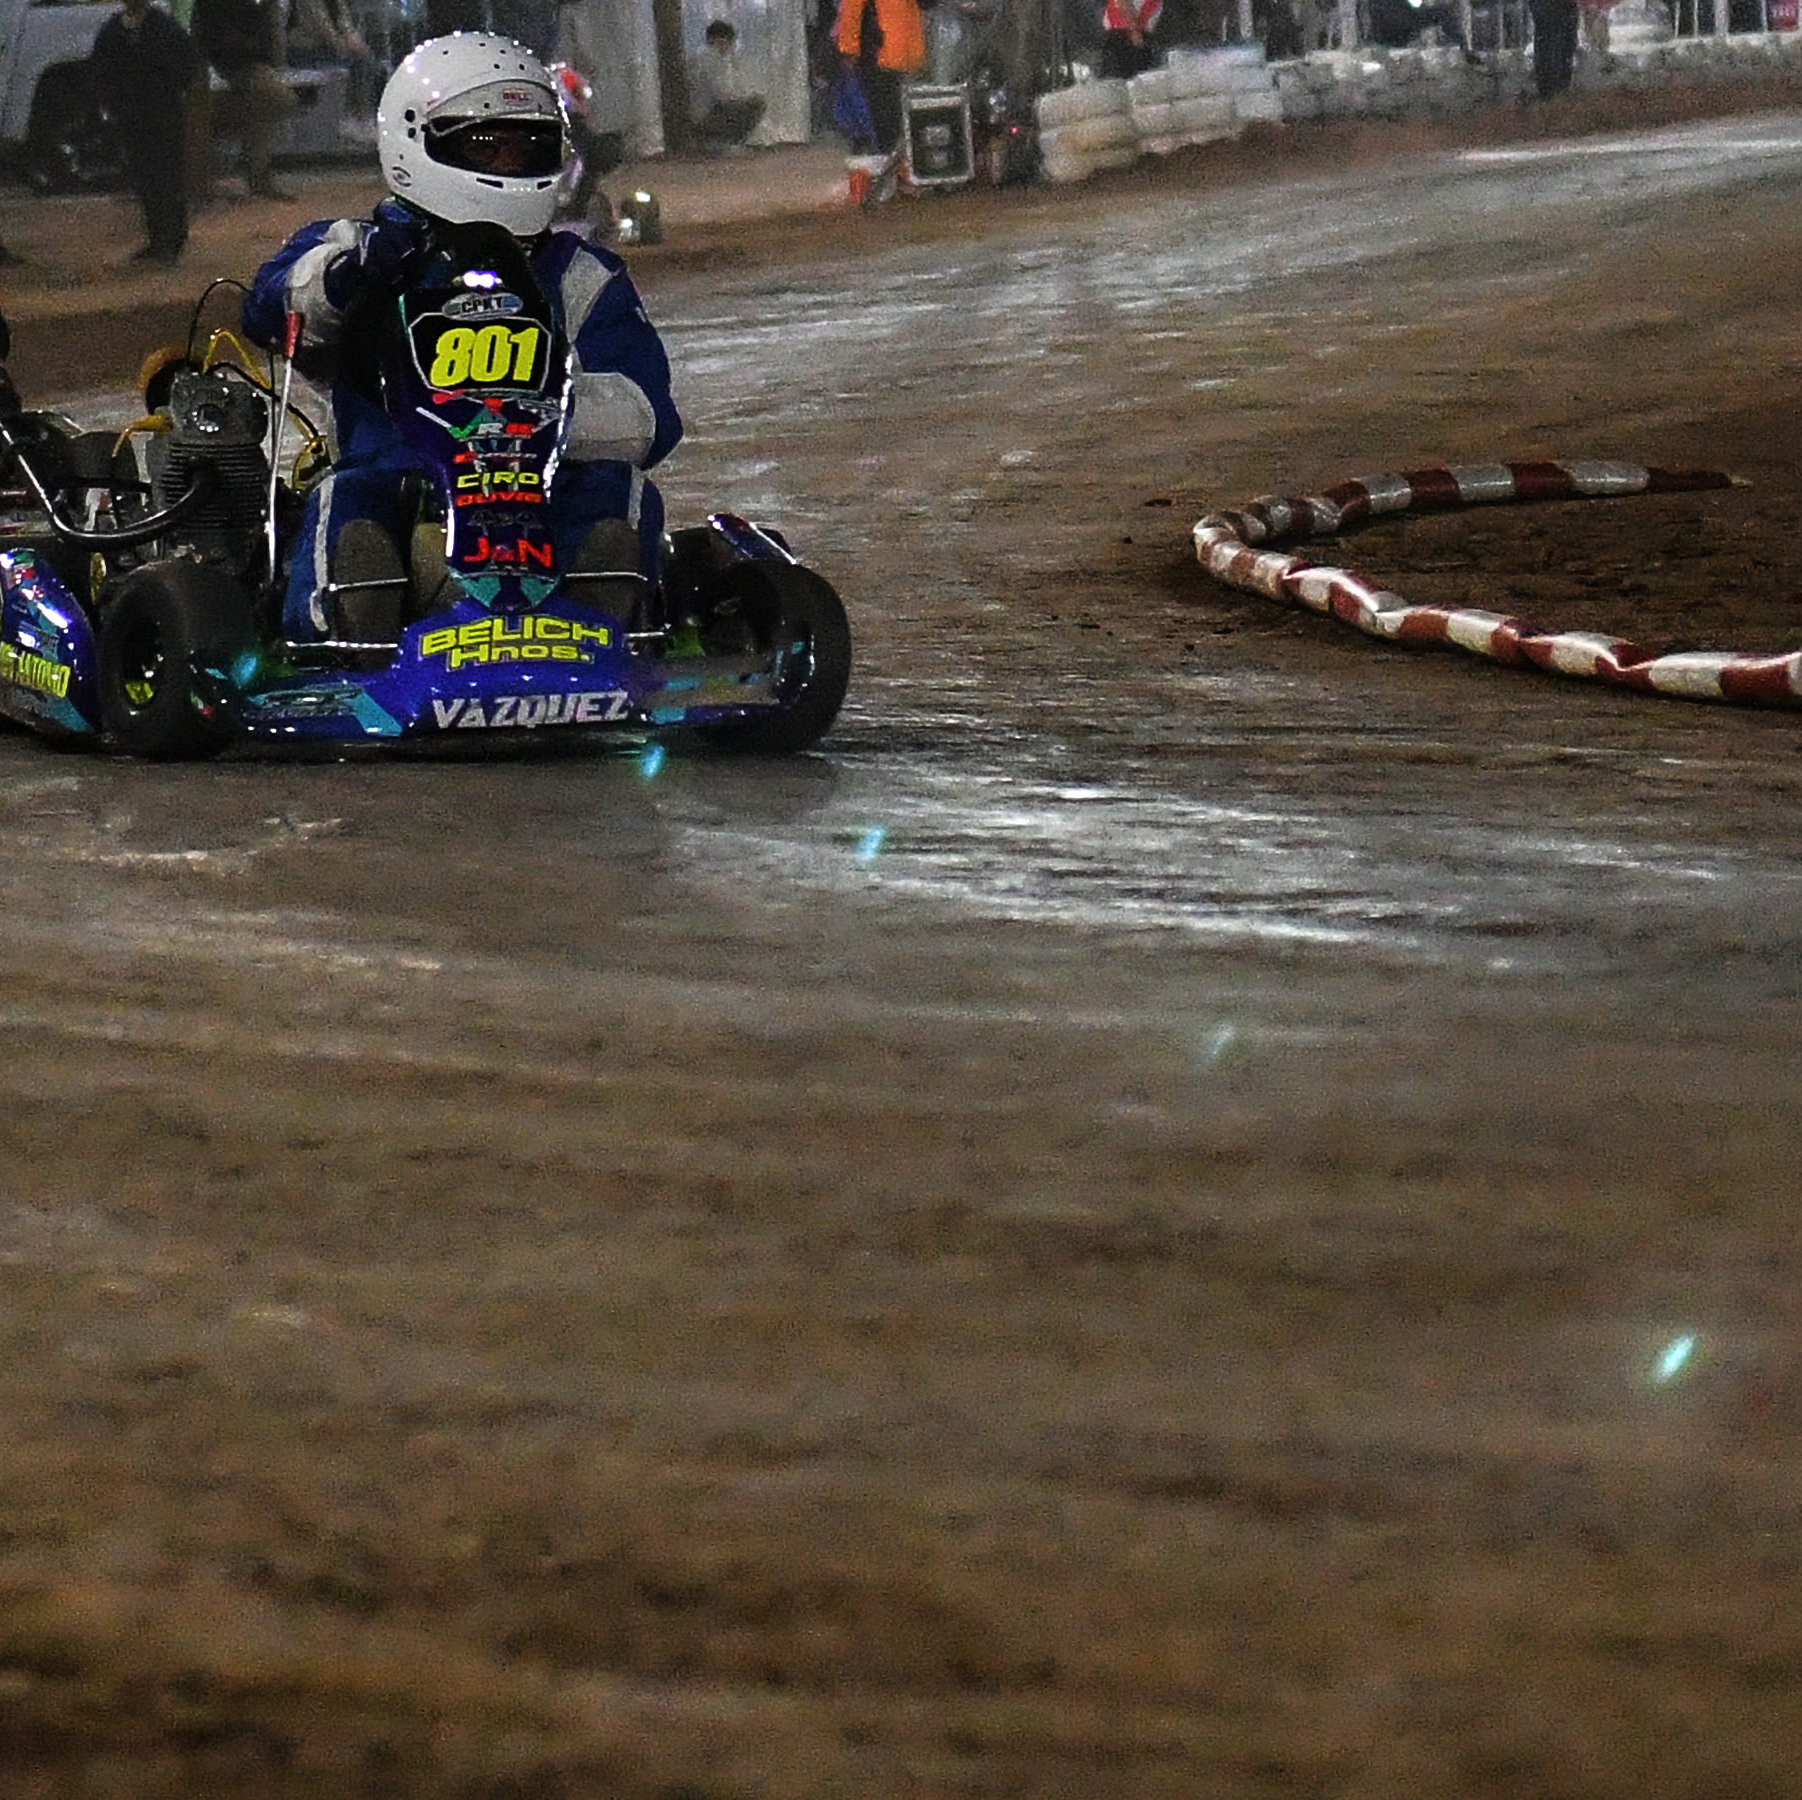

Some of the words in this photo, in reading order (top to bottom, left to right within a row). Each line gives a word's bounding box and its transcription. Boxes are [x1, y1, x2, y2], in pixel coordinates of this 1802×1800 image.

[430, 325, 539, 387] 801
[457, 472, 539, 488] CIRO
[421, 615, 610, 656] BELICH
[432, 691, 629, 729] VAZQUEZ
